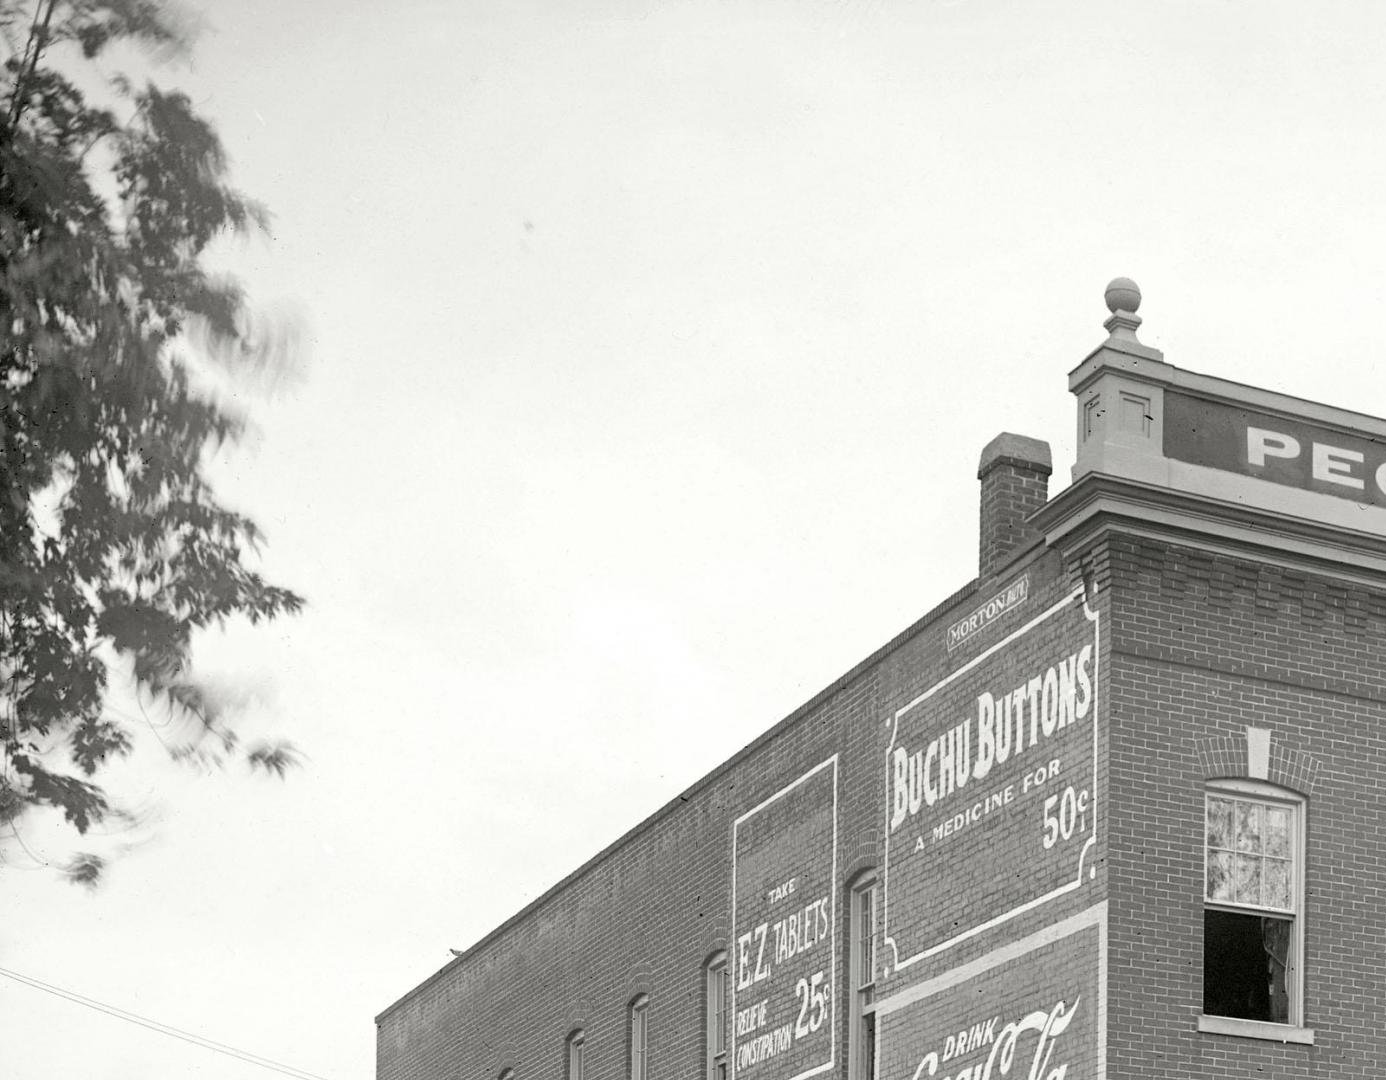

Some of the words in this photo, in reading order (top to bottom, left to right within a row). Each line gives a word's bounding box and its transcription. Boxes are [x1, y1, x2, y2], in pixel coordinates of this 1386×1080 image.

[891, 718, 971, 833] BUCHU
[972, 644, 1092, 779] BUTTONS
[914, 836, 925, 853] A
[932, 785, 1015, 844] MEDICINE
[1023, 759, 1061, 794] FOR
[768, 878, 796, 904] TAKE
[773, 896, 828, 965] TABLETS
[736, 998, 768, 1038] RELIEVE
[943, 1016, 999, 1062] DRINK
[737, 1022, 792, 1071] CONSTIPATION
